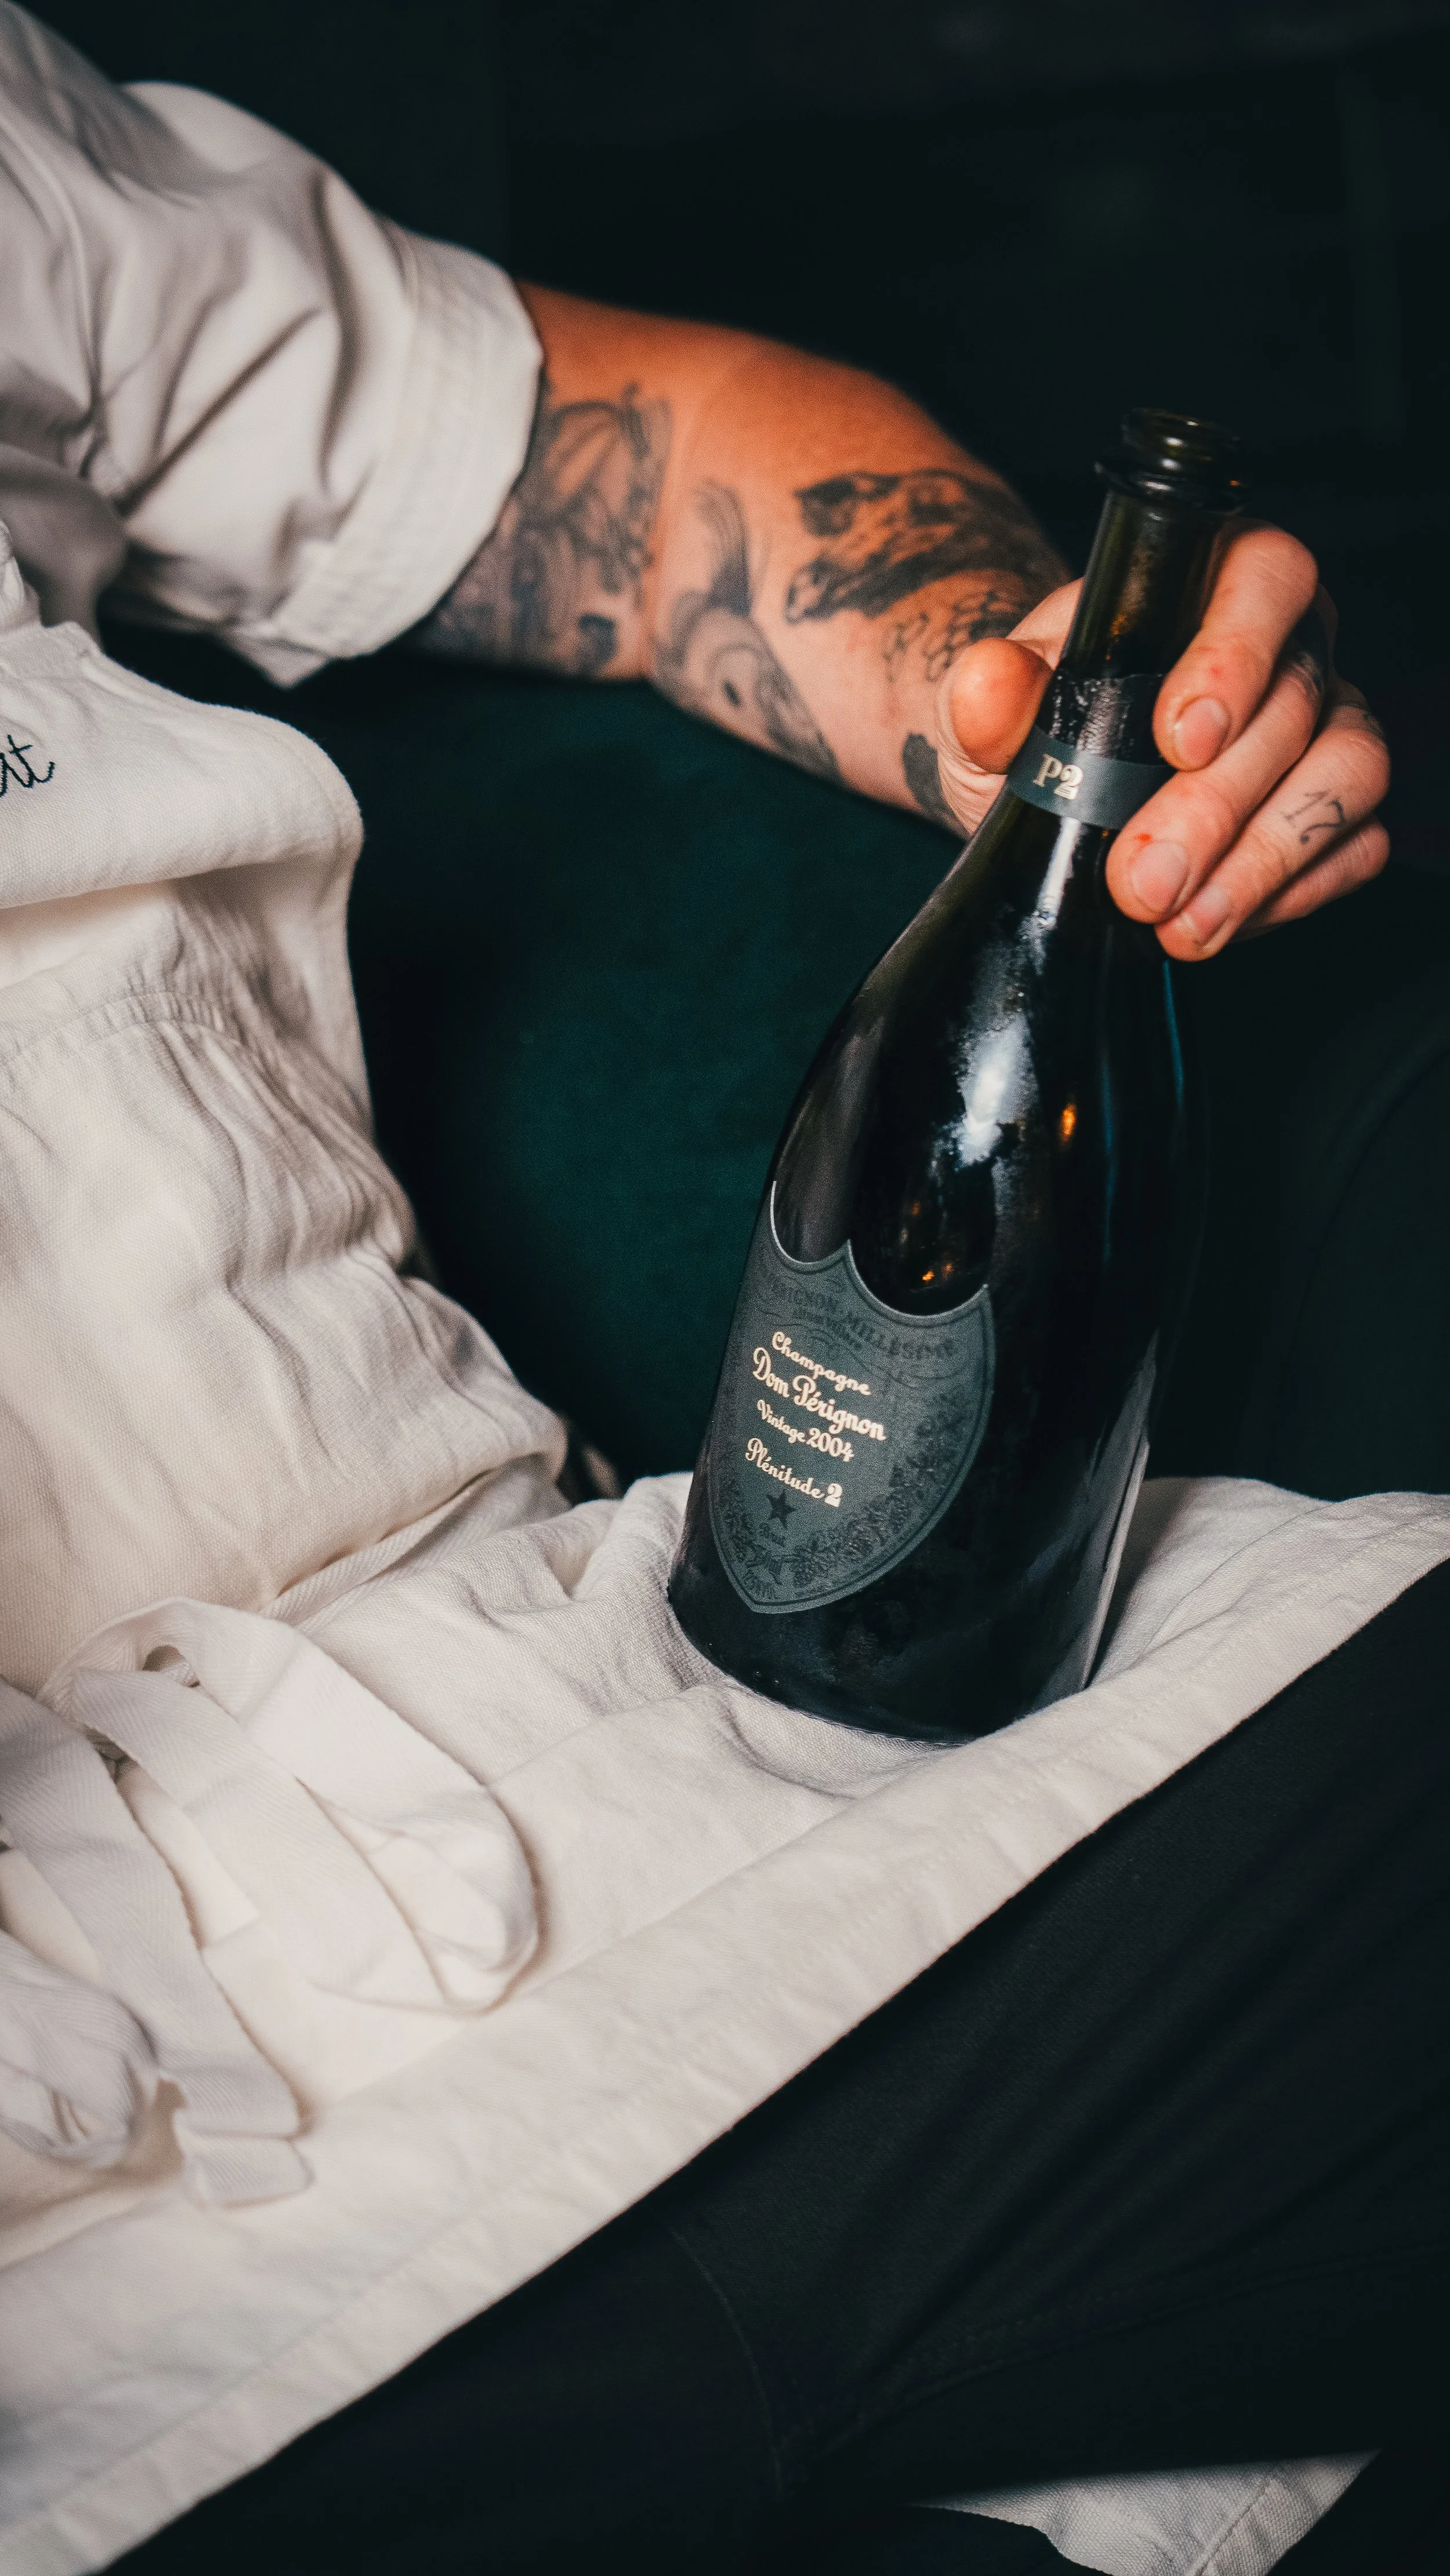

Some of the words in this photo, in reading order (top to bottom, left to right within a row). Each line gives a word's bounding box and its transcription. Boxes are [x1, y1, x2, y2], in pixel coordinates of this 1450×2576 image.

[1032, 753, 1085, 800] P2
[753, 1347, 789, 1398] Dom
[792, 1375, 886, 1441] Pérignon
[772, 1331, 871, 1395] Champagne
[757, 1399, 805, 1443] Vintage
[806, 1428, 854, 1462] 2004
[745, 1438, 825, 1499] Plénitude
[824, 1483, 842, 1508] 2
